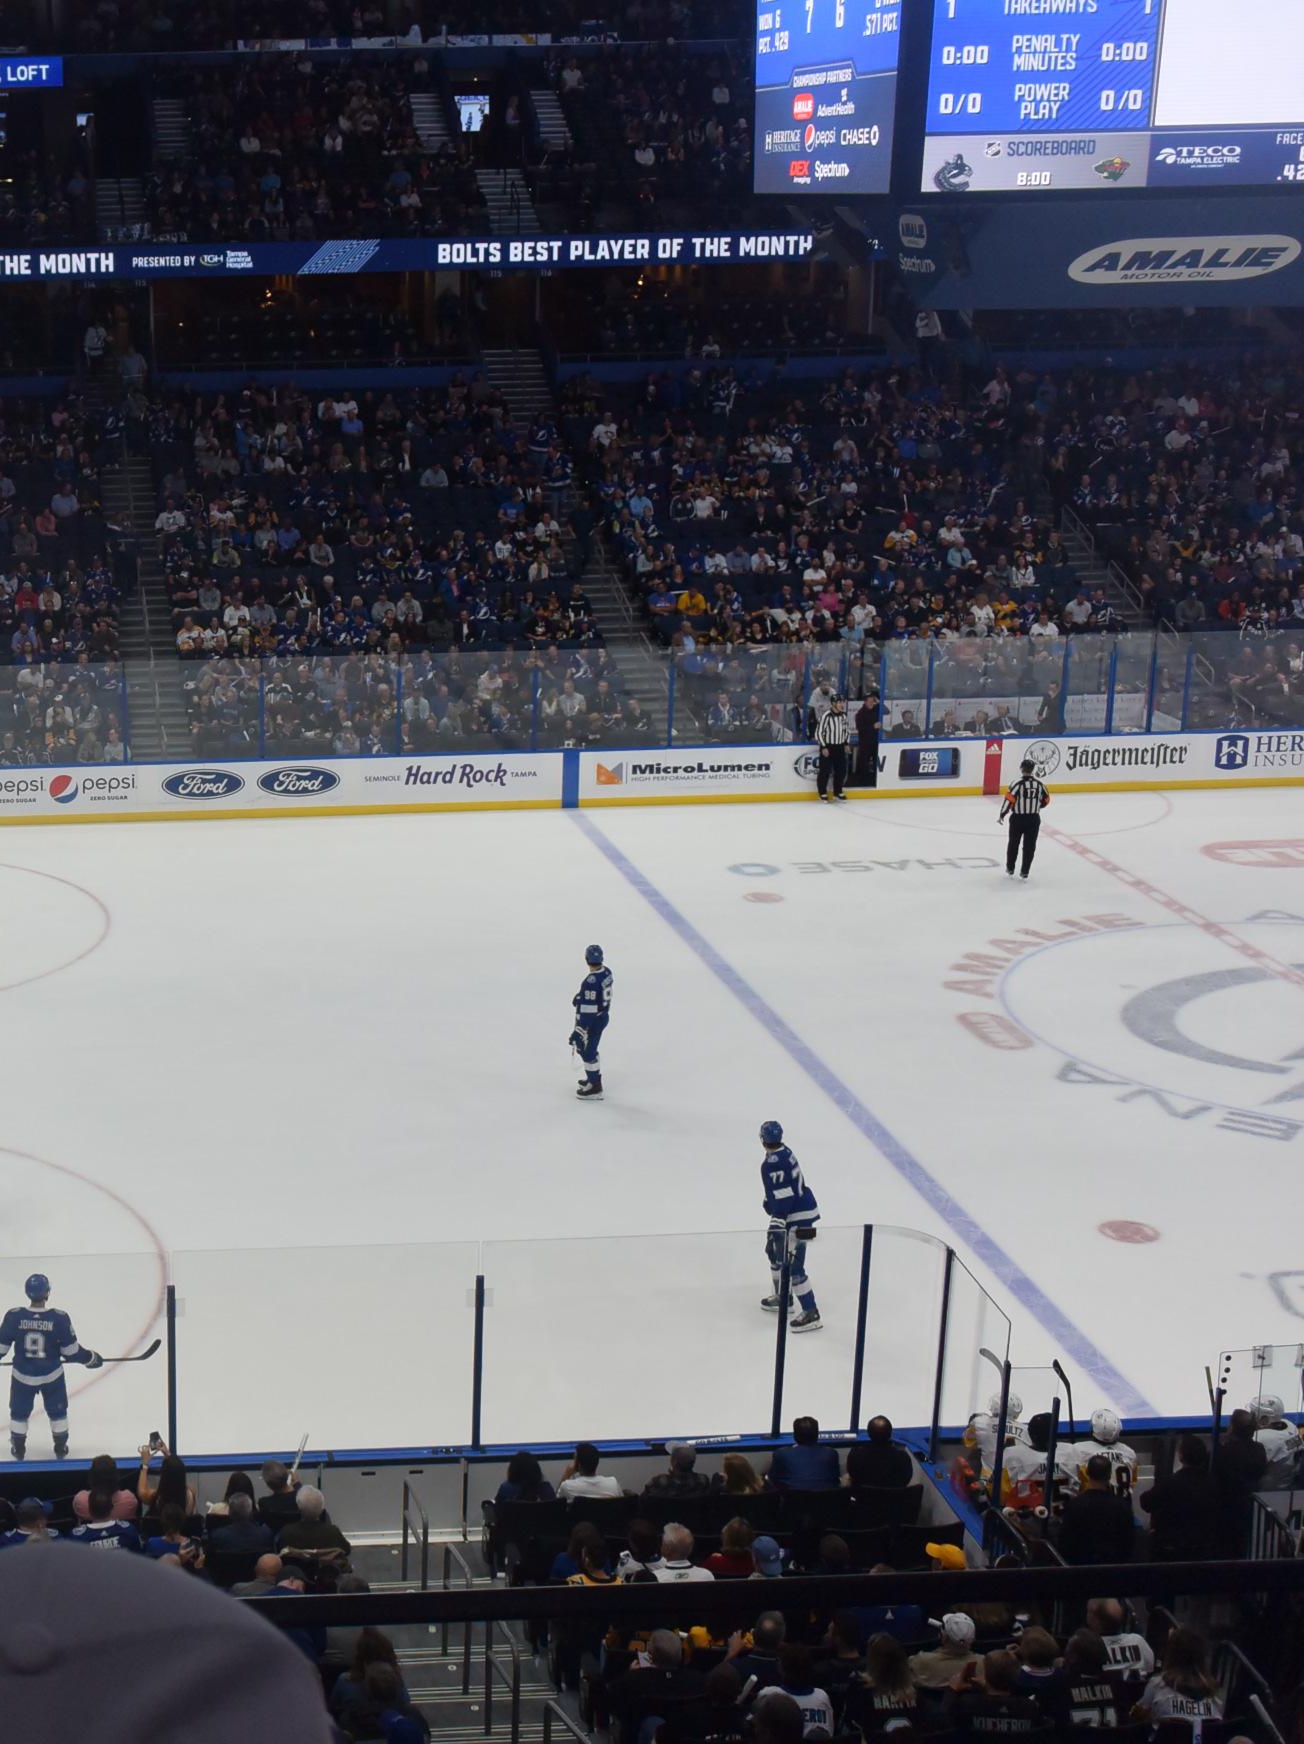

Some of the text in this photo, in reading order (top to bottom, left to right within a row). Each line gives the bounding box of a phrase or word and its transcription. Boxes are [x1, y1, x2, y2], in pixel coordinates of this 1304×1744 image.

[1012, 33, 1080, 53] PENALTY
[1101, 42, 1148, 62] 0:00
[942, 46, 989, 65] 0:00
[1012, 52, 1077, 71] MINUTES
[7, 65, 49, 82] LOFT
[1014, 83, 1070, 102] POWER
[939, 92, 982, 114] 0/0
[1020, 102, 1061, 120] PLAY
[773, 129, 801, 143] HERITAGE
[815, 127, 836, 148] pepsi
[841, 128, 870, 145] CHASE
[1007, 139, 1096, 157] SCOREBOARD
[1176, 146, 1241, 157] TECO
[789, 161, 810, 176] DEX
[1176, 156, 1240, 165] TAMPA ELECTRIC
[815, 161, 848, 181] Spectrum
[1016, 171, 1052, 187] 8:00
[437, 234, 813, 264] BOLTS BEST PLAYER OF THE MONTH
[39, 252, 115, 274] MONTH
[132, 255, 195, 268] PRESENTED BY
[1081, 246, 1290, 273] AMALIE
[1120, 269, 1215, 281] MOTOR OIL
[803, 756, 820, 770] FO
[920, 752, 938, 760] FOX
[364, 763, 537, 788] SEMINOLE Hard Rock TAMPA
[631, 761, 770, 776] MicroLumen
[654, 773, 707, 781] PERFORMANCE
[708, 772, 741, 780] MEDICAL
[742, 771, 770, 779] TUBING
[919, 764, 938, 773] GO
[82, 773, 136, 794] pepsi
[178, 773, 228, 796] Ford
[273, 769, 323, 793] Ford
[793, 855, 1004, 875] CHASE
[942, 912, 1145, 999] AMALIE
[769, 1170, 785, 1184] 77
[18, 1319, 54, 1331] JOHNSON
[24, 1332, 46, 1359] 9
[992, 1423, 1024, 1437] SULTZ
[1172, 1697, 1213, 1716] HAGELIN
